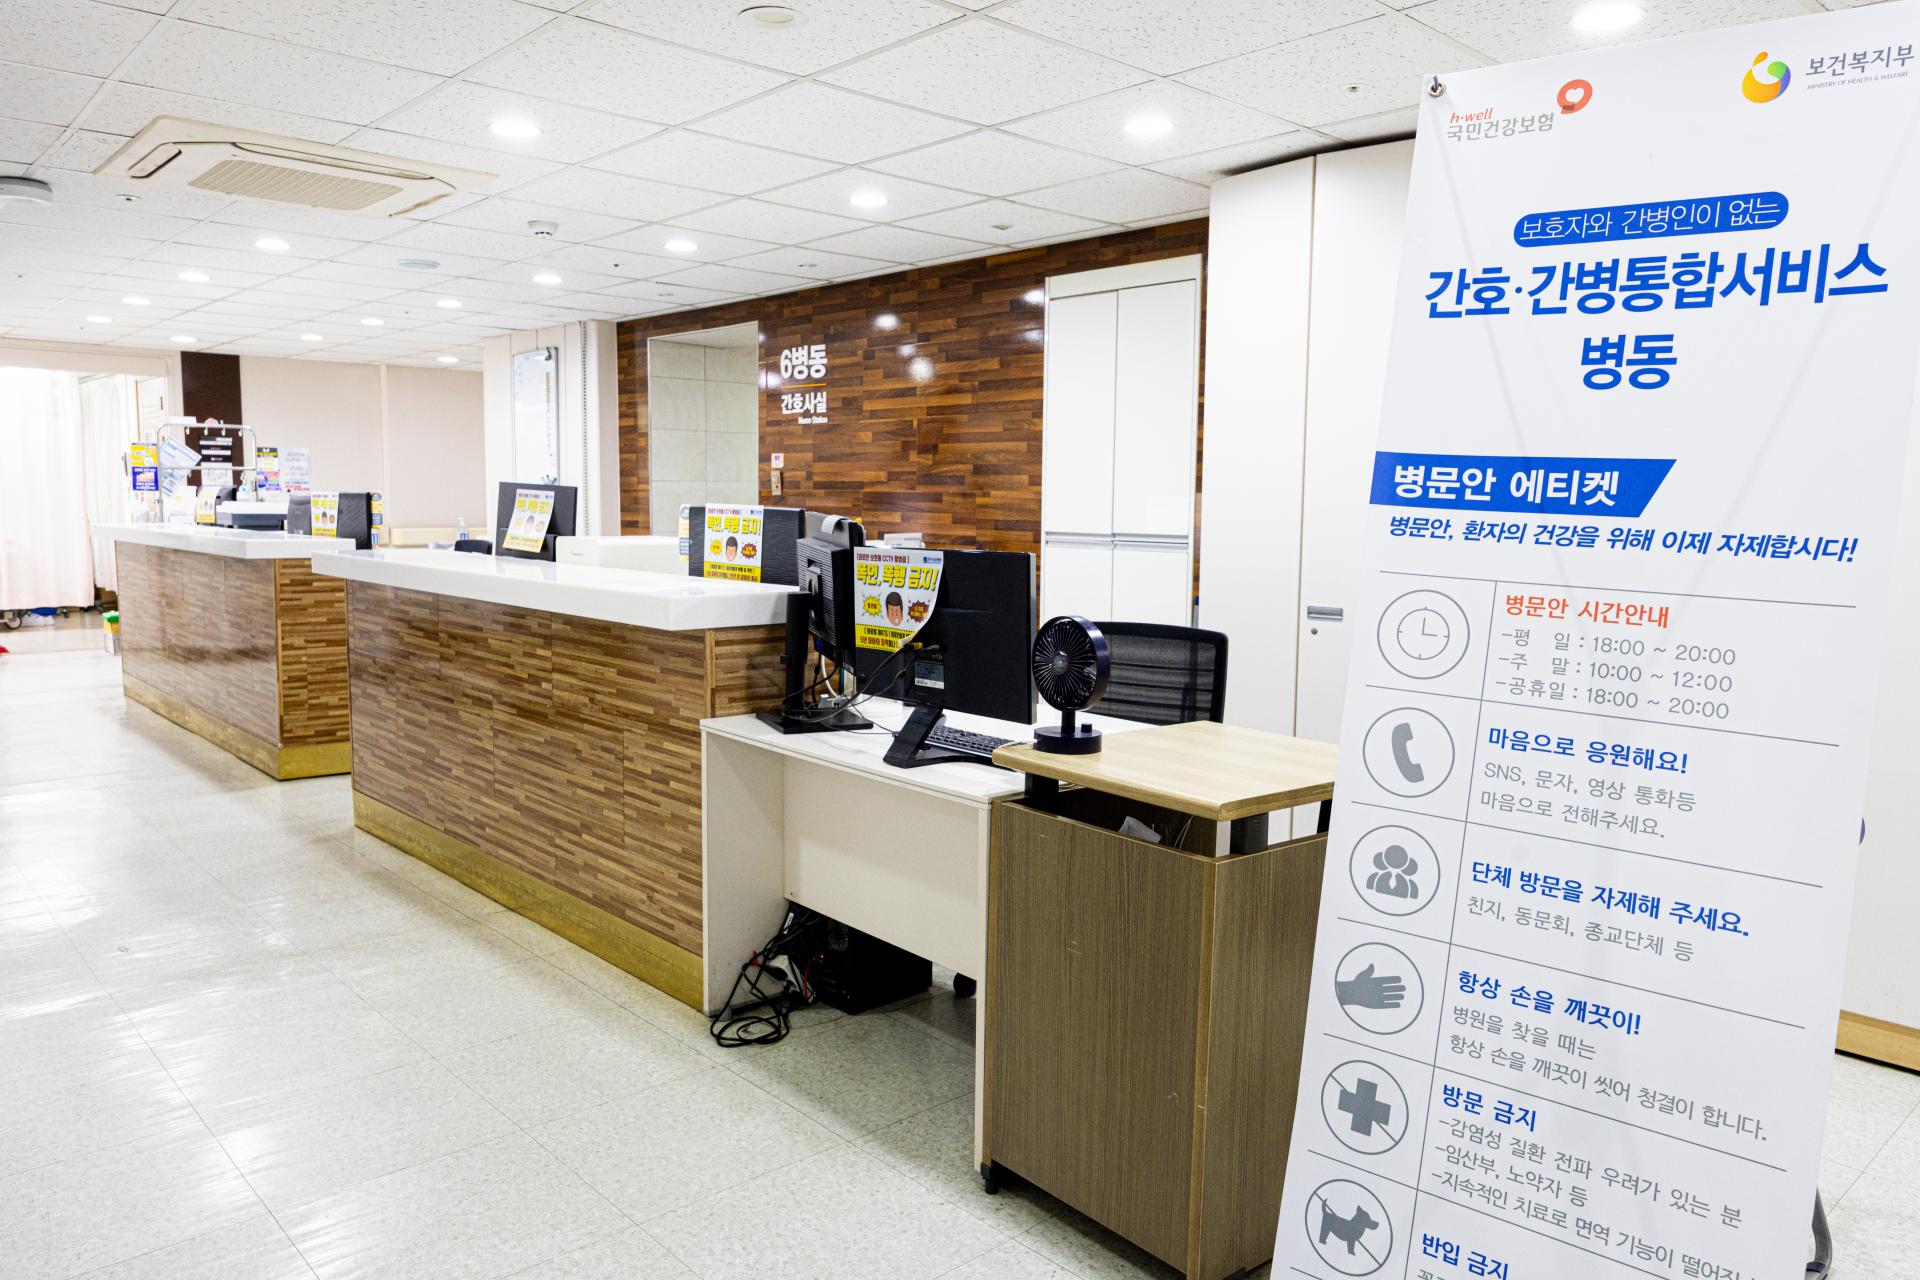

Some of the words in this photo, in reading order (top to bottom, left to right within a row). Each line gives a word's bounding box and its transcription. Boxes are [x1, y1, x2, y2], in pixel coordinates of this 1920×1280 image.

[1806, 44, 1915, 76] 보건복지부
[1807, 81, 1837, 90] MINISTRY
[1847, 77, 1874, 86] HEALTH
[1880, 71, 1909, 81] WELFARE
[1447, 113, 1555, 142] 국민건강보험
[1520, 211, 1612, 240] 보호자와
[1621, 201, 1721, 235] 간병인이
[1728, 197, 1781, 226] 없는
[780, 344, 828, 380] 6병동
[1580, 334, 1678, 390] 병동
[781, 392, 827, 415] 간호사실
[1394, 465, 1496, 502] 병문안
[1511, 469, 1619, 506] 에티켓
[1390, 517, 1454, 541] 병문안,
[1462, 520, 1528, 545] 환자의
[1533, 524, 1599, 548] 건강을
[1607, 528, 1653, 551] 위해
[1662, 530, 1712, 554] 이제
[1717, 534, 1859, 562] 자제합시다!
[883, 564, 907, 588] 폭행
[908, 566, 940, 591] 금지!
[1506, 595, 1569, 619] 병문안
[1578, 600, 1669, 629] 시간안내
[1592, 636, 1645, 657] 18:00
[1675, 644, 1736, 665] 20:00
[1590, 662, 1642, 683] 10:00
[1673, 671, 1733, 693] 12:00
[1586, 688, 1639, 709] 18:00
[1668, 697, 1729, 719] 20:00
[1489, 728, 1575, 757] 마음으로
[1586, 741, 1688, 774] 응원해요!
[1484, 762, 1526, 786] SNS,
[1536, 770, 1578, 794] 문자,
[1588, 778, 1626, 801] 영상
[1634, 785, 1696, 812] 통화등
[1480, 791, 1553, 817] 마음으로
[1562, 804, 1665, 838] 전해주세요.
[1472, 862, 1512, 888] 단체
[1520, 871, 1584, 903] 방문을
[1592, 886, 1661, 919] 자제해
[1669, 901, 1749, 937] 주세요.
[1468, 896, 1506, 922] 친지,
[1514, 907, 1574, 937] 동문회,
[1584, 922, 1664, 955] 종교단체
[1674, 940, 1695, 962] 등
[1459, 970, 1501, 1000] 항상
[1510, 986, 1555, 1014] 손을
[1564, 998, 1641, 1035] 깨끗이!
[1454, 1006, 1504, 1034] 병원을
[1512, 1022, 1549, 1048] 찾을
[1558, 1034, 1596, 1061] 때는
[1443, 1084, 1483, 1116] 방문
[1494, 1100, 1537, 1132] 금지
[1450, 1034, 1485, 1059] 항상
[1490, 1048, 1526, 1072] 손을
[1532, 1057, 1587, 1090] 깨끗이
[1594, 1076, 1631, 1102] 씻어
[1638, 1088, 1694, 1121] 청결이
[1702, 1105, 1767, 1141] 합니다.
[1507, 1166, 1563, 1199] 노약자
[1568, 1185, 1589, 1208] 등
[1509, 1138, 1546, 1166] 질환
[1554, 1151, 1593, 1180] 전파
[1602, 1167, 1661, 1202] 우려가
[1670, 1189, 1711, 1219] 있는
[1720, 1205, 1743, 1229] 분
[1514, 1197, 1568, 1229] 치료로
[1576, 1217, 1610, 1246] 면역
[1616, 1232, 1674, 1269] 기능이
[1423, 1233, 1460, 1266] 반입
[1468, 1250, 1509, 1280] 금지
